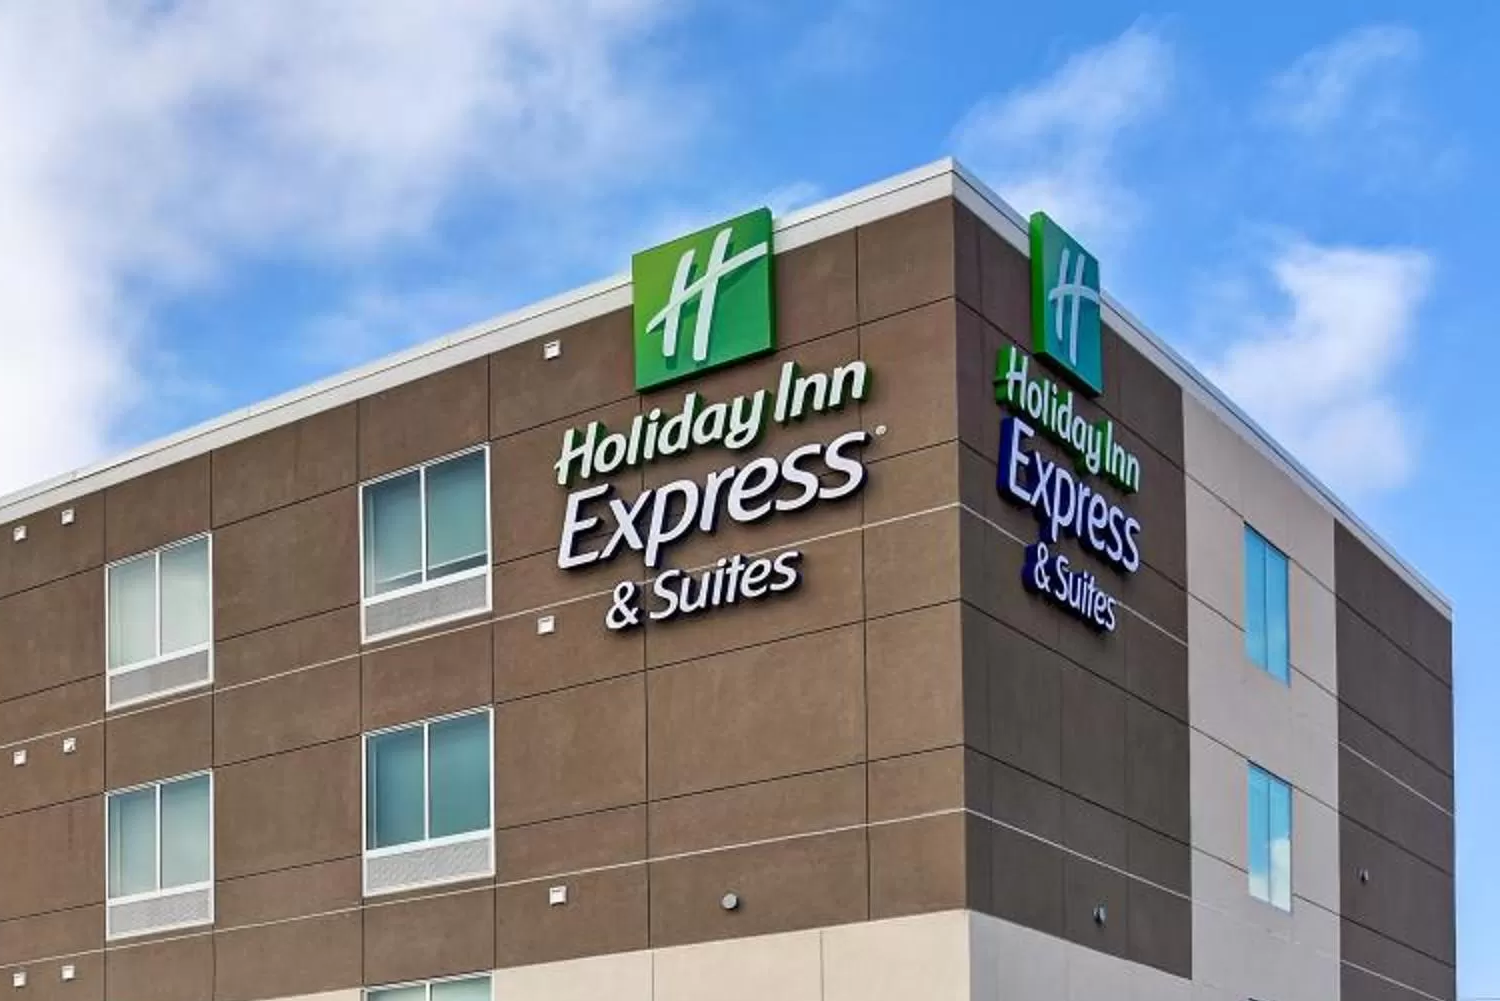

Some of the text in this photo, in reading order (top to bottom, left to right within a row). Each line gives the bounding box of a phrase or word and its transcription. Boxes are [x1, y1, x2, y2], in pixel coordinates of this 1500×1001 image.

[553, 360, 868, 485] Holiday Inn
[1004, 345, 1141, 493] Holiday Inn
[557, 431, 867, 569] Express
[1007, 416, 1142, 573] Express
[604, 550, 801, 630] & Suites
[1032, 540, 1118, 633] & Suites
